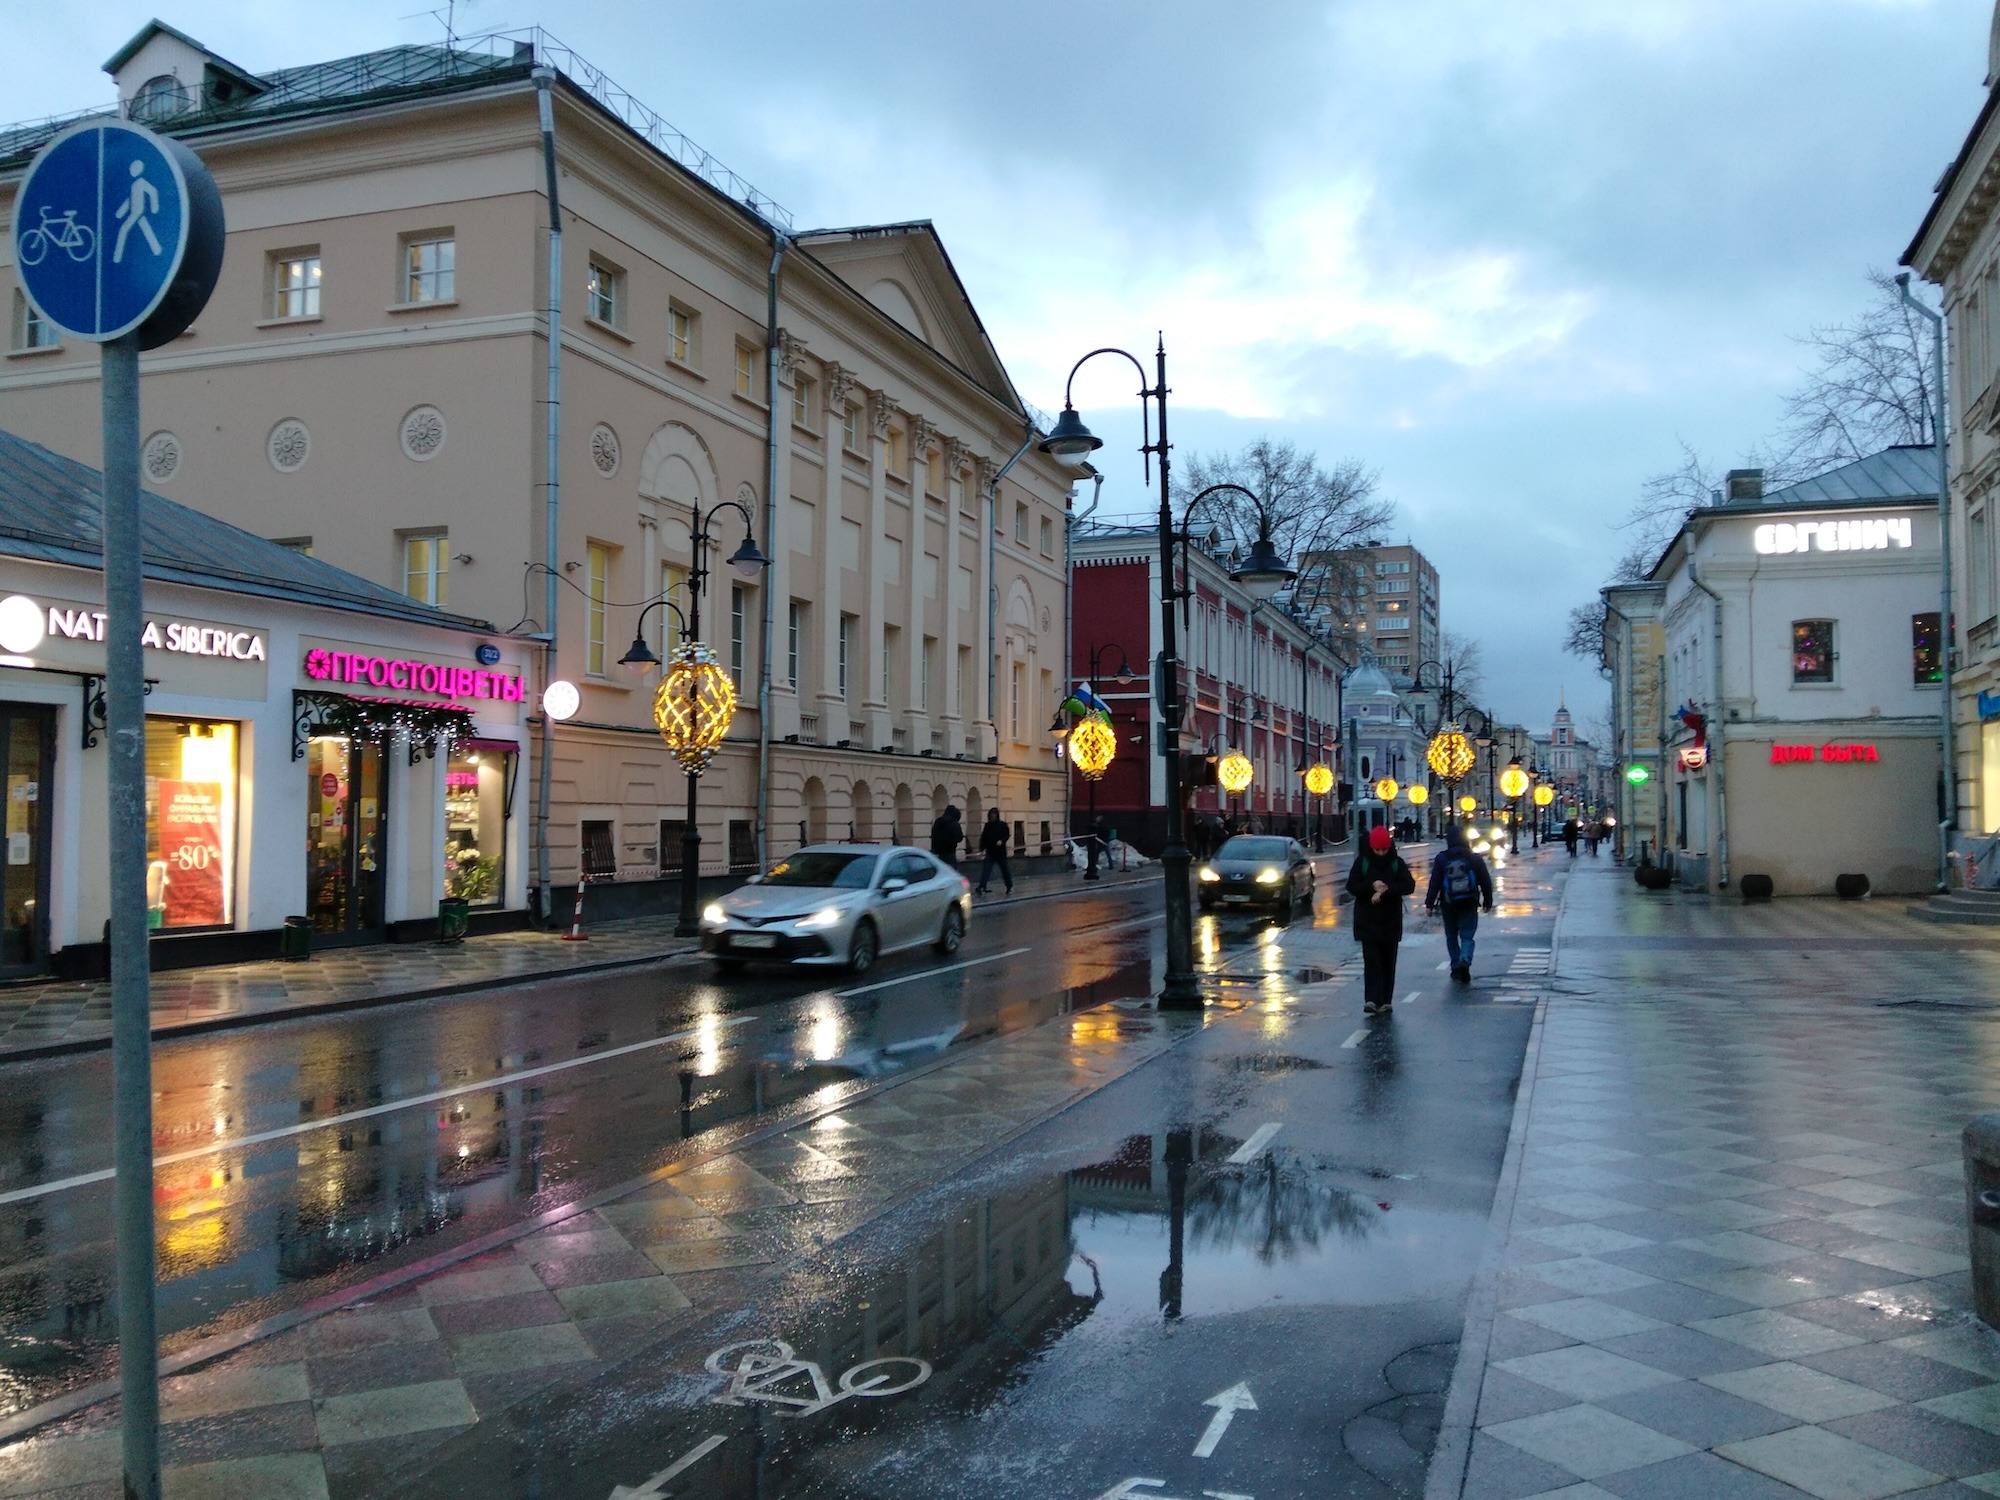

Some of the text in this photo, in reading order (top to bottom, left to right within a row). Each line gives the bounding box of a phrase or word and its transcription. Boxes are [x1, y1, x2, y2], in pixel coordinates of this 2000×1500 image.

[1755, 518, 1912, 554] ЕВГЕНИЧ
[49, 607, 265, 661] NATA SIBERICA
[331, 651, 524, 702] ПРОСТОЦВЕТЫ
[1769, 745, 1879, 765] ДОМ БЫТА
